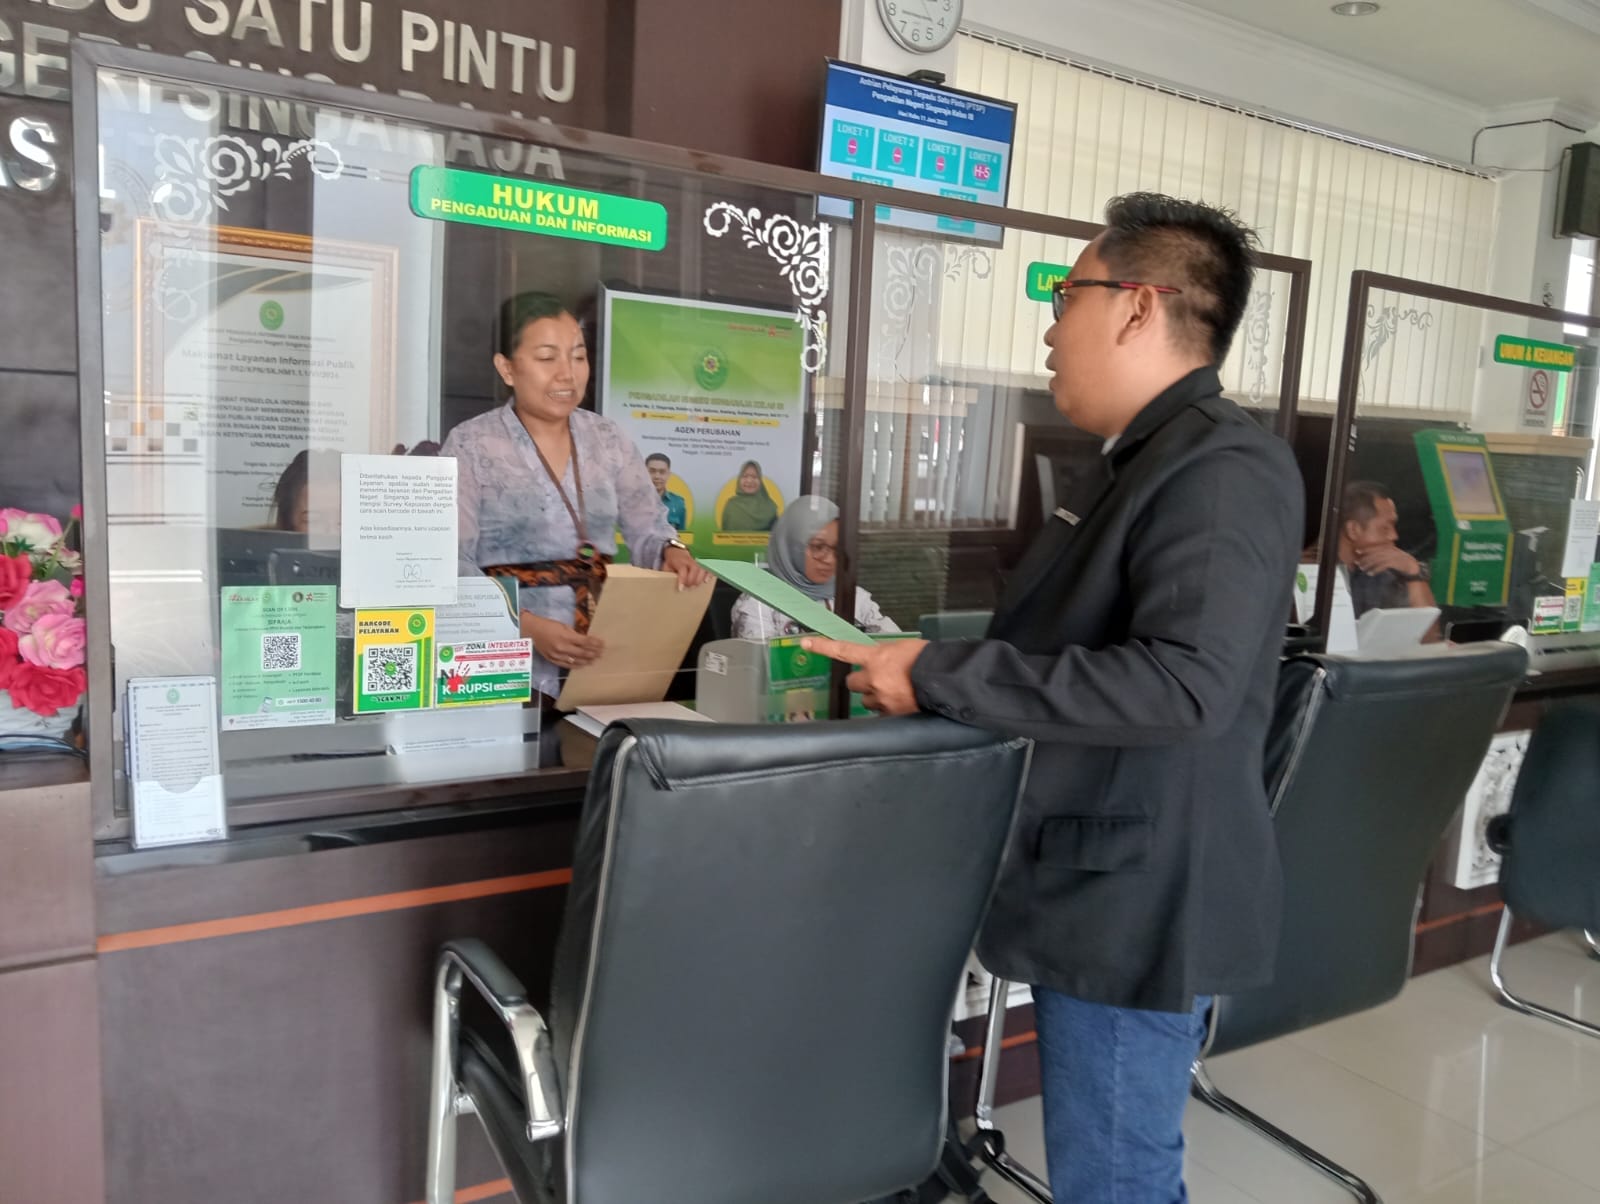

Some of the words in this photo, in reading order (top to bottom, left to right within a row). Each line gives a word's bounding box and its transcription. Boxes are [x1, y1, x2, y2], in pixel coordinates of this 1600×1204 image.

[888, 2, 897, 16] 8
[899, 20, 907, 34] 7
[937, 17, 945, 29] 4
[912, 29, 920, 42] 6
[925, 27, 934, 40] 5
[184, 0, 373, 64] SATU
[401, 9, 576, 103] PINTU
[838, 124, 862, 135] LOKET
[884, 134, 907, 145] LOKET
[909, 138, 915, 147] 2
[928, 143, 950, 154] LOKET
[952, 147, 958, 156] 3
[969, 151, 991, 162] LOKET
[492, 183, 599, 220] HUKUM
[431, 198, 531, 225] PENGADUAN
[535, 214, 567, 230] DAN
[572, 219, 652, 243] INFORMASI
[236, 352, 277, 365] Layanan
[280, 356, 325, 368] Informasi
[674, 426, 695, 435] AGEN
[696, 427, 741, 437] PERUBAHAN
[360, 480, 384, 488] Layanan
[388, 488, 411, 496] layanan
[359, 627, 400, 635] PELAYANAN
[465, 642, 487, 650] ZONA
[487, 640, 529, 649] INTEGRITAS
